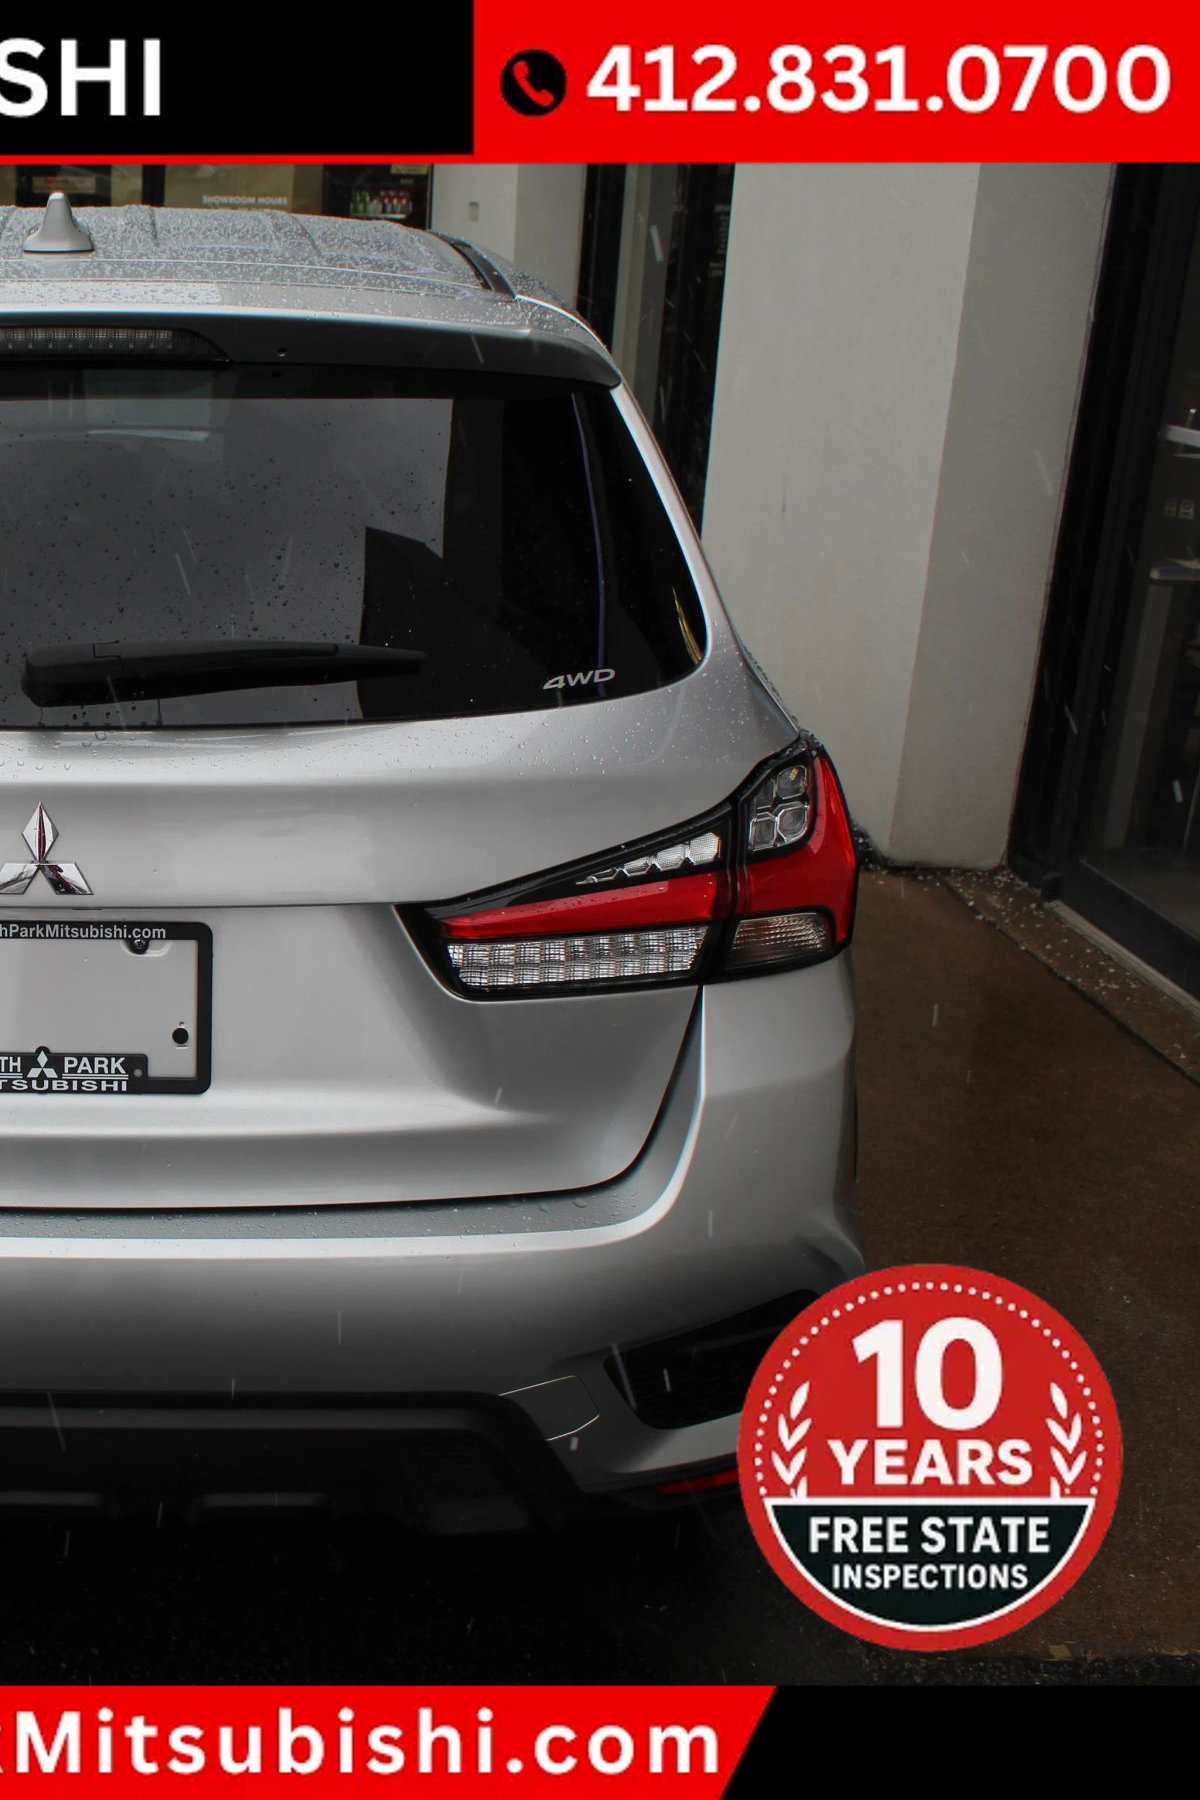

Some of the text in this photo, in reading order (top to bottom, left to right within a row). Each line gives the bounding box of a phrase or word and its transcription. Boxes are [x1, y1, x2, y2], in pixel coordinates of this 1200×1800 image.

[202, 195, 288, 207] SHOWROOM HOURS
[542, 668, 616, 690] 4WD
[63, 1056, 127, 1074] PARK
